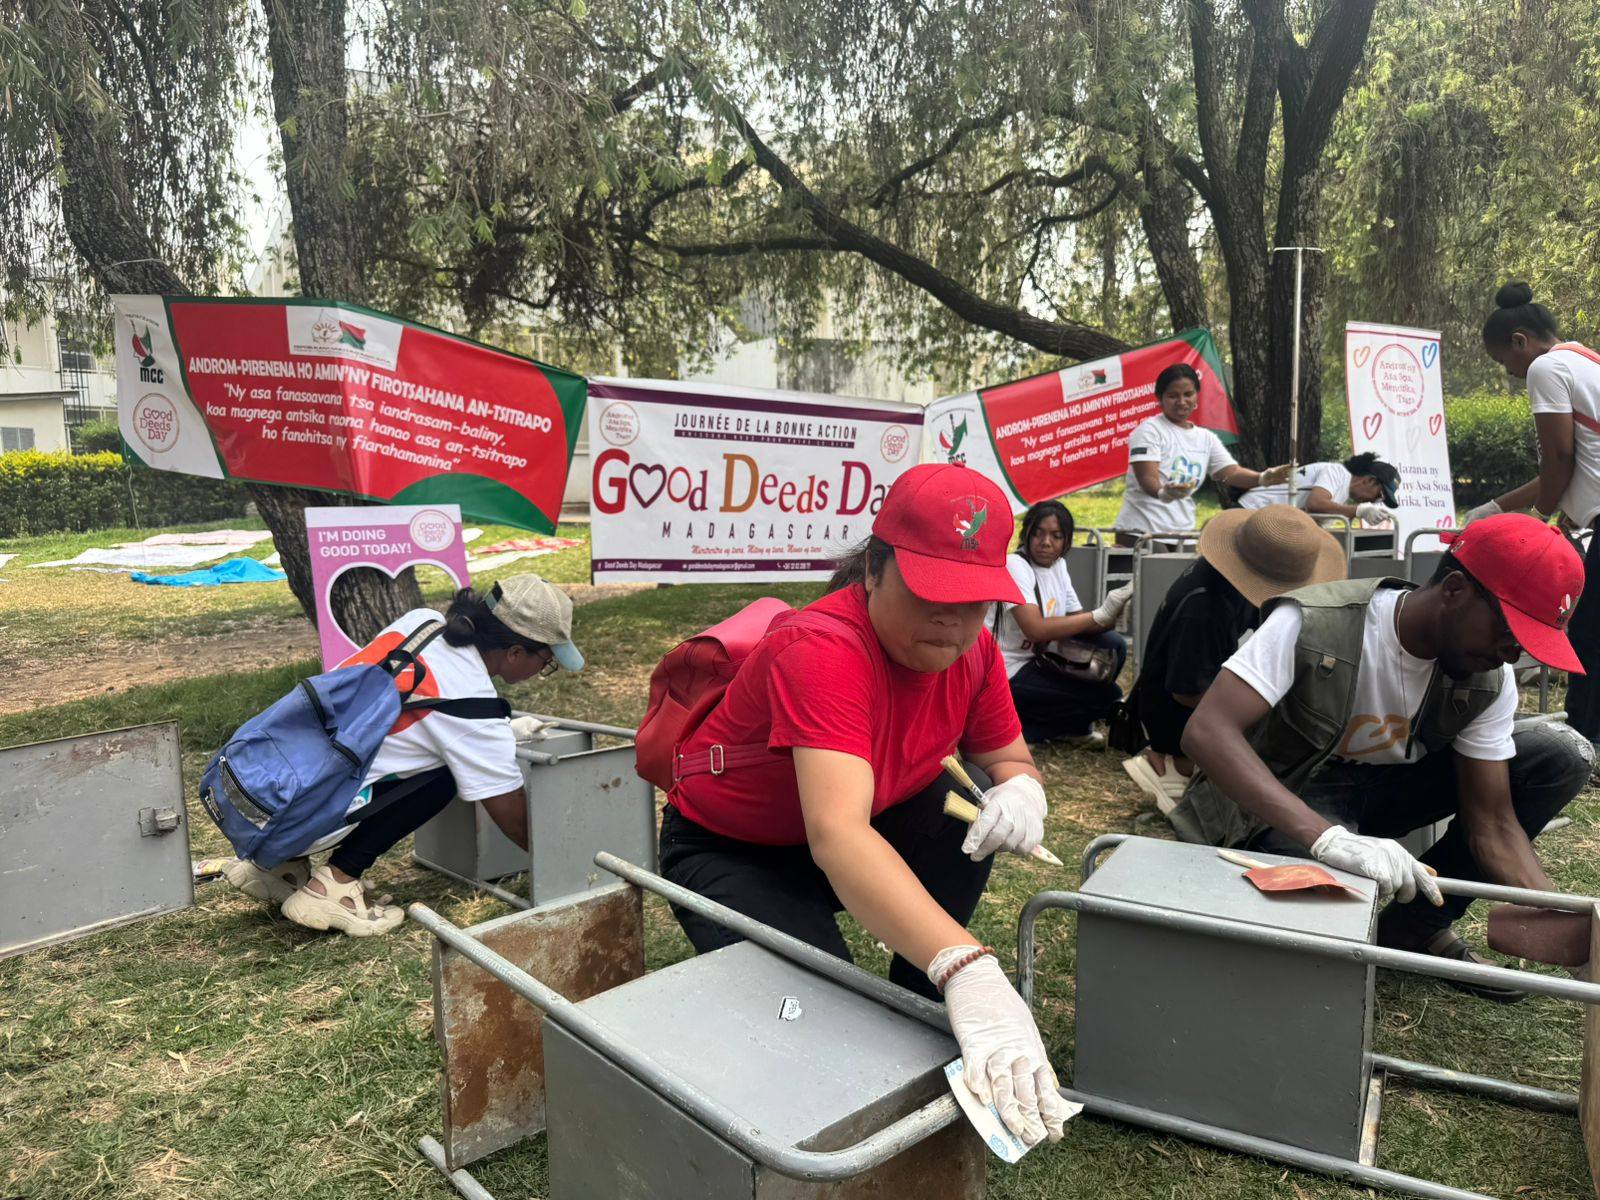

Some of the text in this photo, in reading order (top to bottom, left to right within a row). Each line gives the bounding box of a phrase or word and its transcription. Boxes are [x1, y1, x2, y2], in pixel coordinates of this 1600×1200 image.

[189, 357, 552, 433] ANDROM-PIRENENA HO AMIN'NY FIROTSAHANA AN-TSITRAPO
[139, 417, 171, 432] Deeds
[142, 407, 173, 422] Good
[250, 387, 271, 400] asa
[275, 386, 343, 406] fanasoavana
[349, 394, 374, 411] tsa
[380, 400, 507, 447] iandrasam-baliny,
[996, 408, 1070, 440] ANDROM-PIRENENA
[1069, 404, 1082, 417] HO
[147, 429, 168, 443] Day
[206, 401, 226, 416] koa
[230, 405, 282, 424] magnega
[286, 409, 325, 424] antsika
[369, 417, 411, 441] hanao
[414, 433, 440, 448] asa
[445, 439, 528, 469] an-tsitrapo
[262, 424, 278, 440] ho
[281, 427, 333, 445] fanohitsa
[336, 436, 347, 451] ny
[674, 413, 857, 440] JOURNÉE DE LA BONNE ACTION
[1039, 432, 1054, 443] asa
[1056, 416, 1104, 439] fanasoavana
[1105, 411, 1118, 423] tsa
[1010, 454, 1026, 467] koa
[1050, 456, 1060, 469] ho
[1099, 443, 1109, 454] ny
[592, 448, 892, 516] Good Deeds Da
[1415, 481, 1431, 491] Asa
[1422, 496, 1446, 507] Tsara
[318, 529, 387, 542] I'M DOING
[661, 521, 849, 541] MADAGASCAR
[320, 543, 412, 557] GOOD TODAY!
